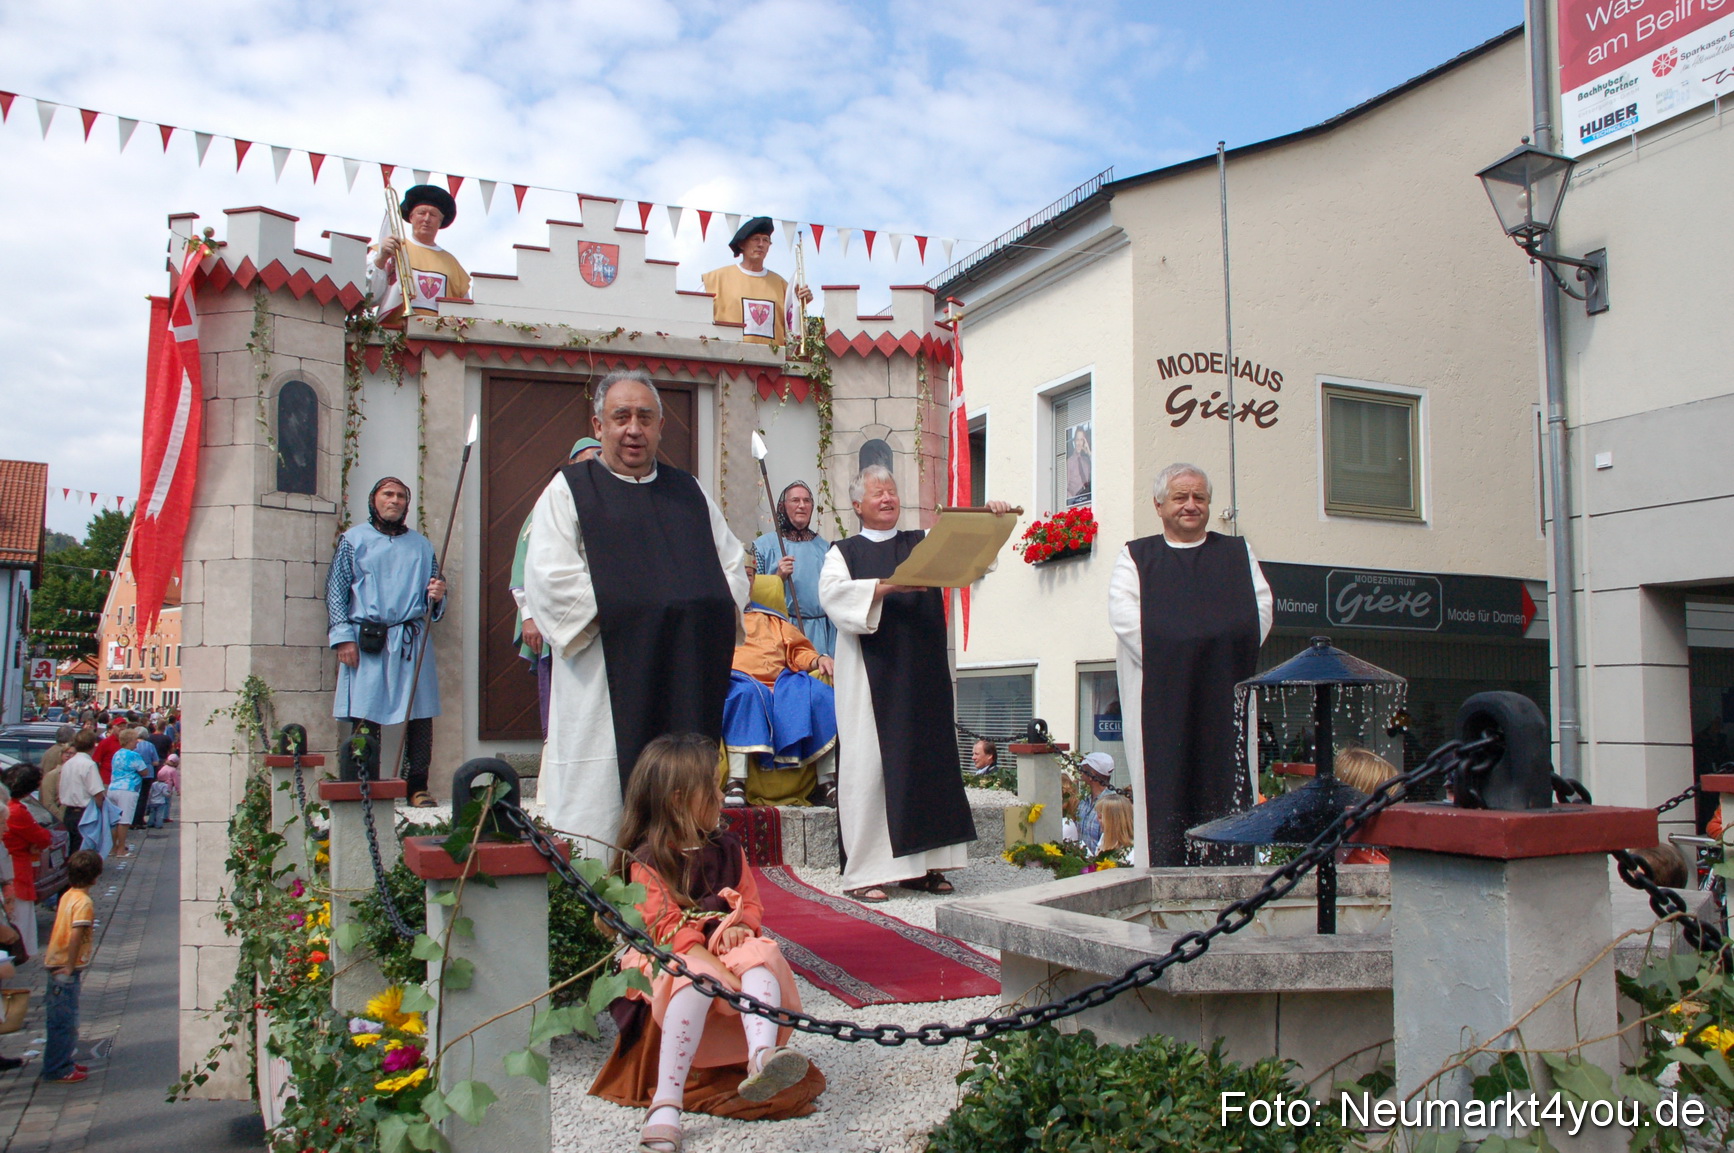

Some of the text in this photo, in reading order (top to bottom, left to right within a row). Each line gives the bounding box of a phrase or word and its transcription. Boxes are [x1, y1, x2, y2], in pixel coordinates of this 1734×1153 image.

[1588, 33, 1628, 65] am
[1680, 35, 1727, 61] Sparkasse
[1577, 75, 1624, 101] Bachhuber
[1604, 77, 1639, 98] Partner
[1579, 102, 1638, 138] HUBER
[1156, 352, 1284, 392] MODEHAUS
[1354, 574, 1416, 586] MODEZENTRUM
[1277, 598, 1319, 613] Männer
[1448, 608, 1526, 625] Mode für Damen
[1099, 722, 1121, 730] CECIL
